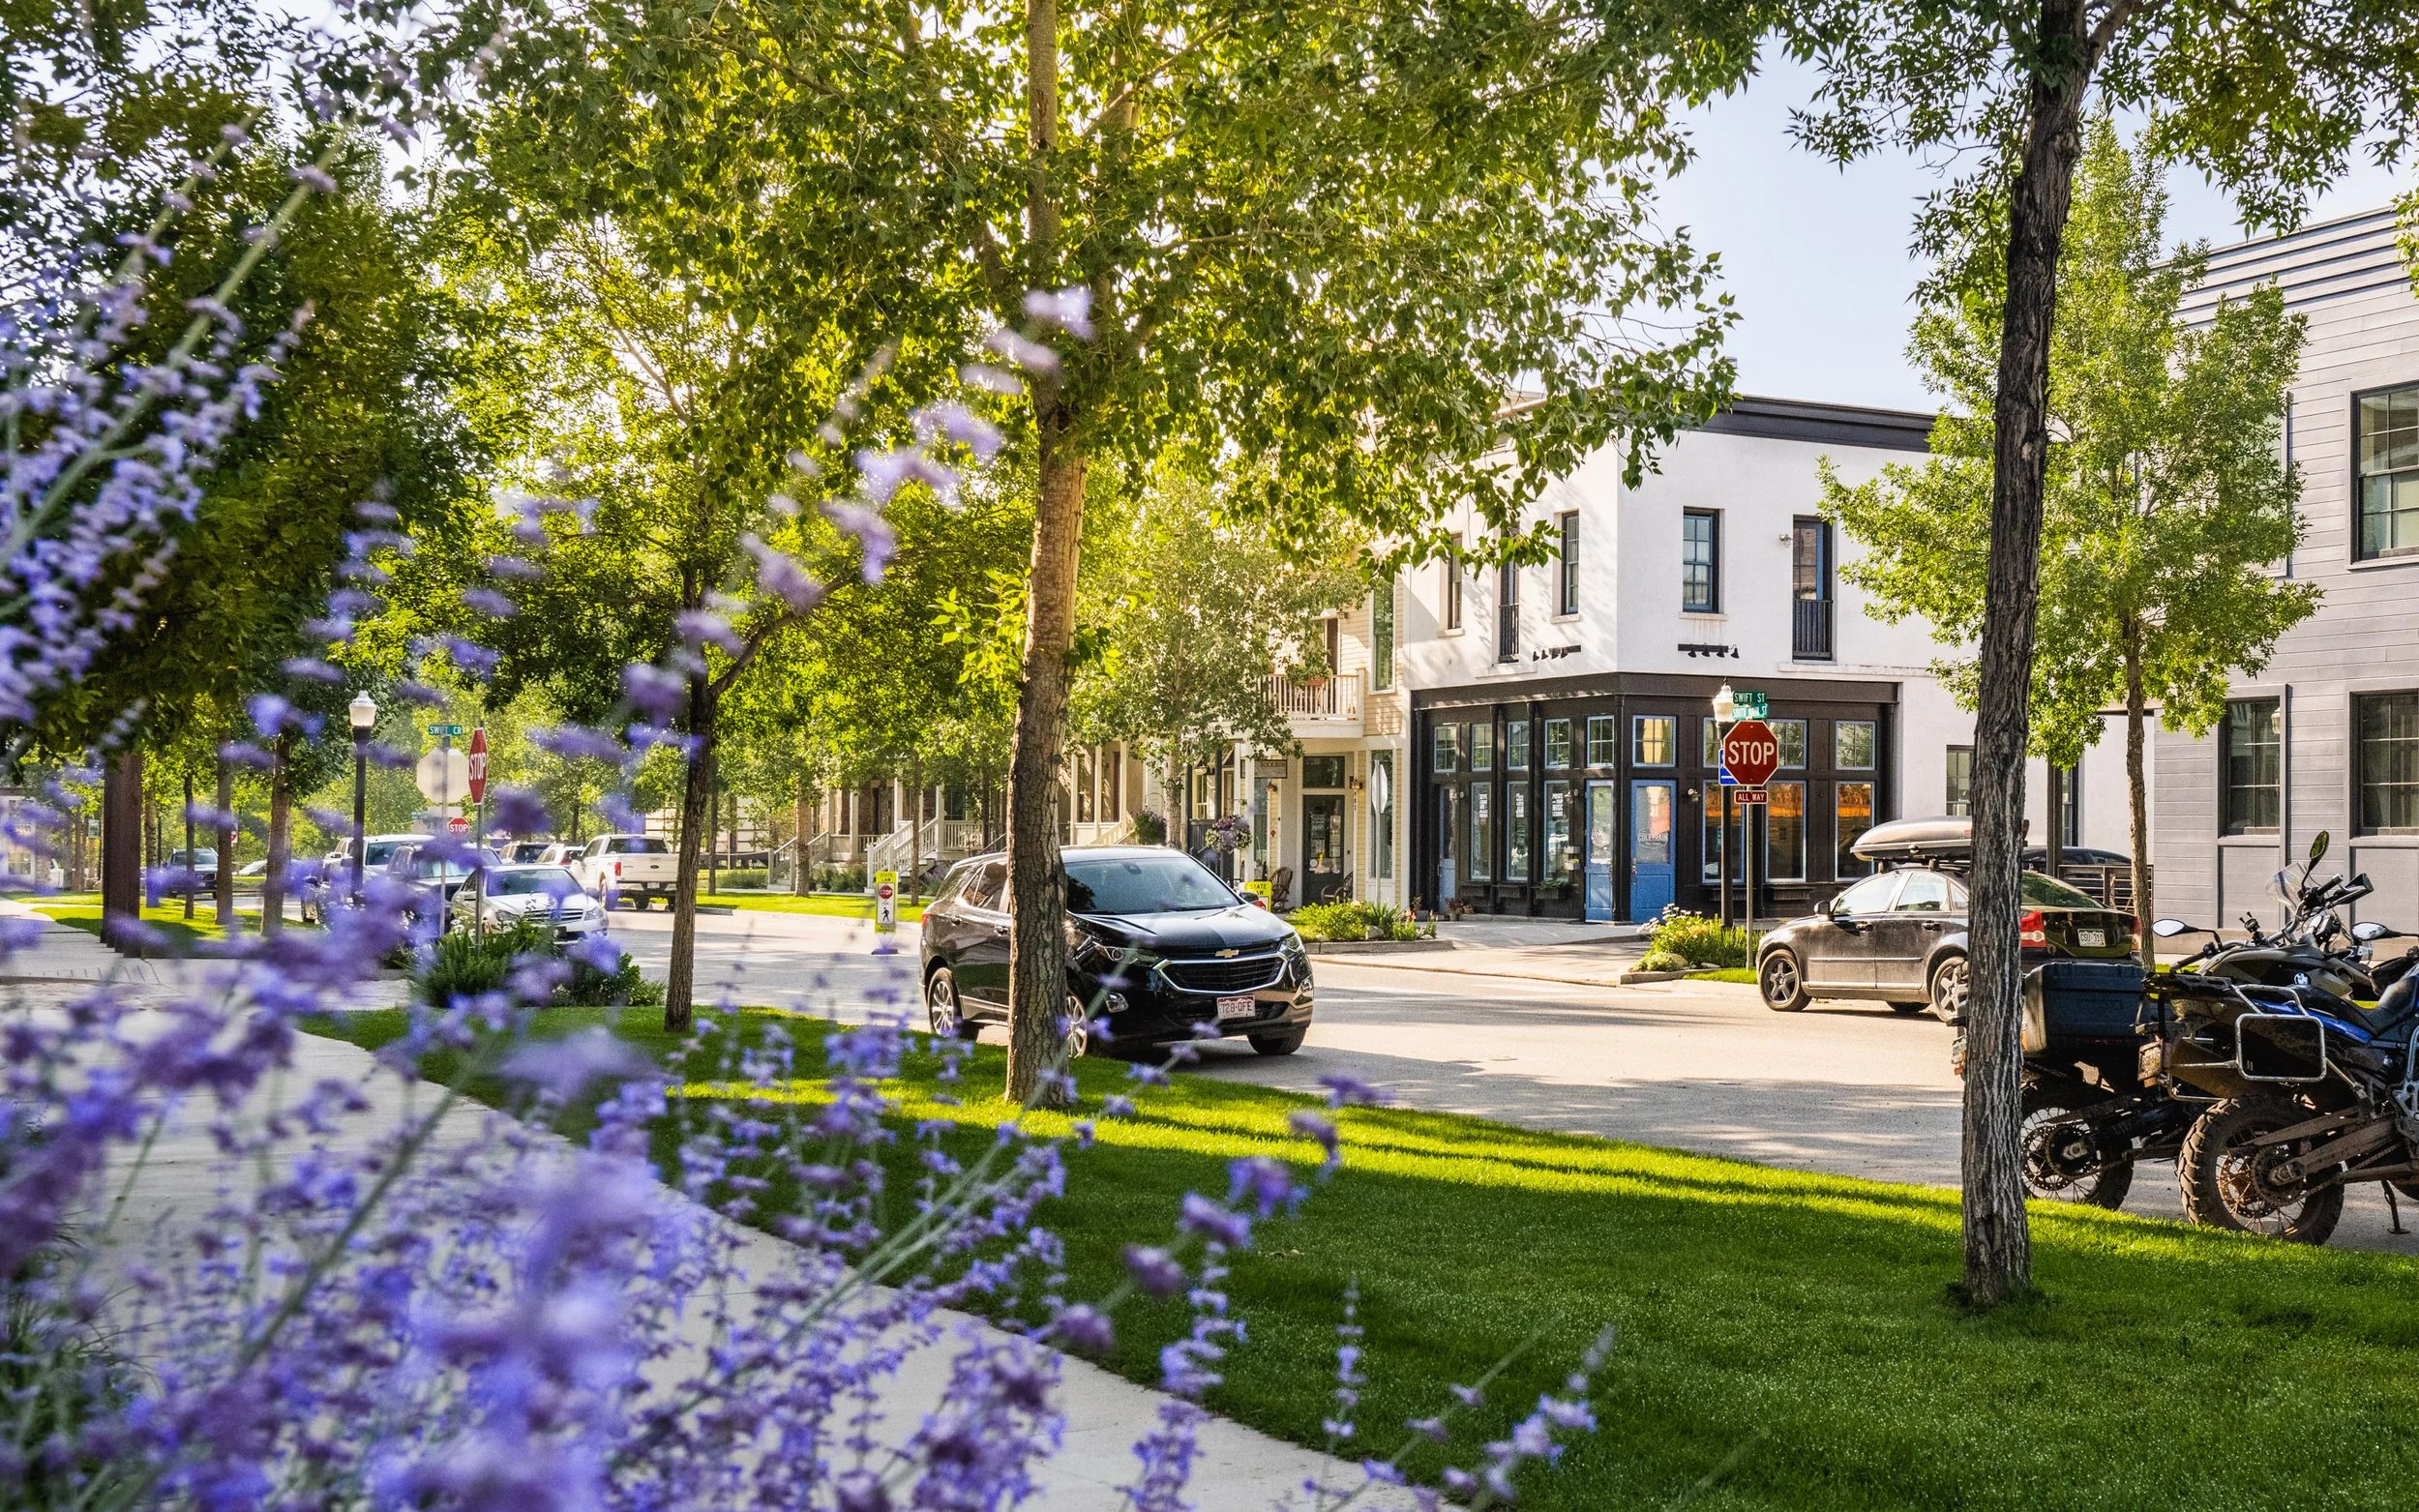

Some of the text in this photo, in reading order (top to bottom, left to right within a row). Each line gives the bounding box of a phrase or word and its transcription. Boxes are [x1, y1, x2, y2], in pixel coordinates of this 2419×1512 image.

[1734, 693, 1766, 703] SWIFT ST
[453, 726, 463, 734] CR
[1727, 741, 1775, 765] STOP
[469, 753, 486, 781] STOP
[449, 824, 468, 833] STOP
